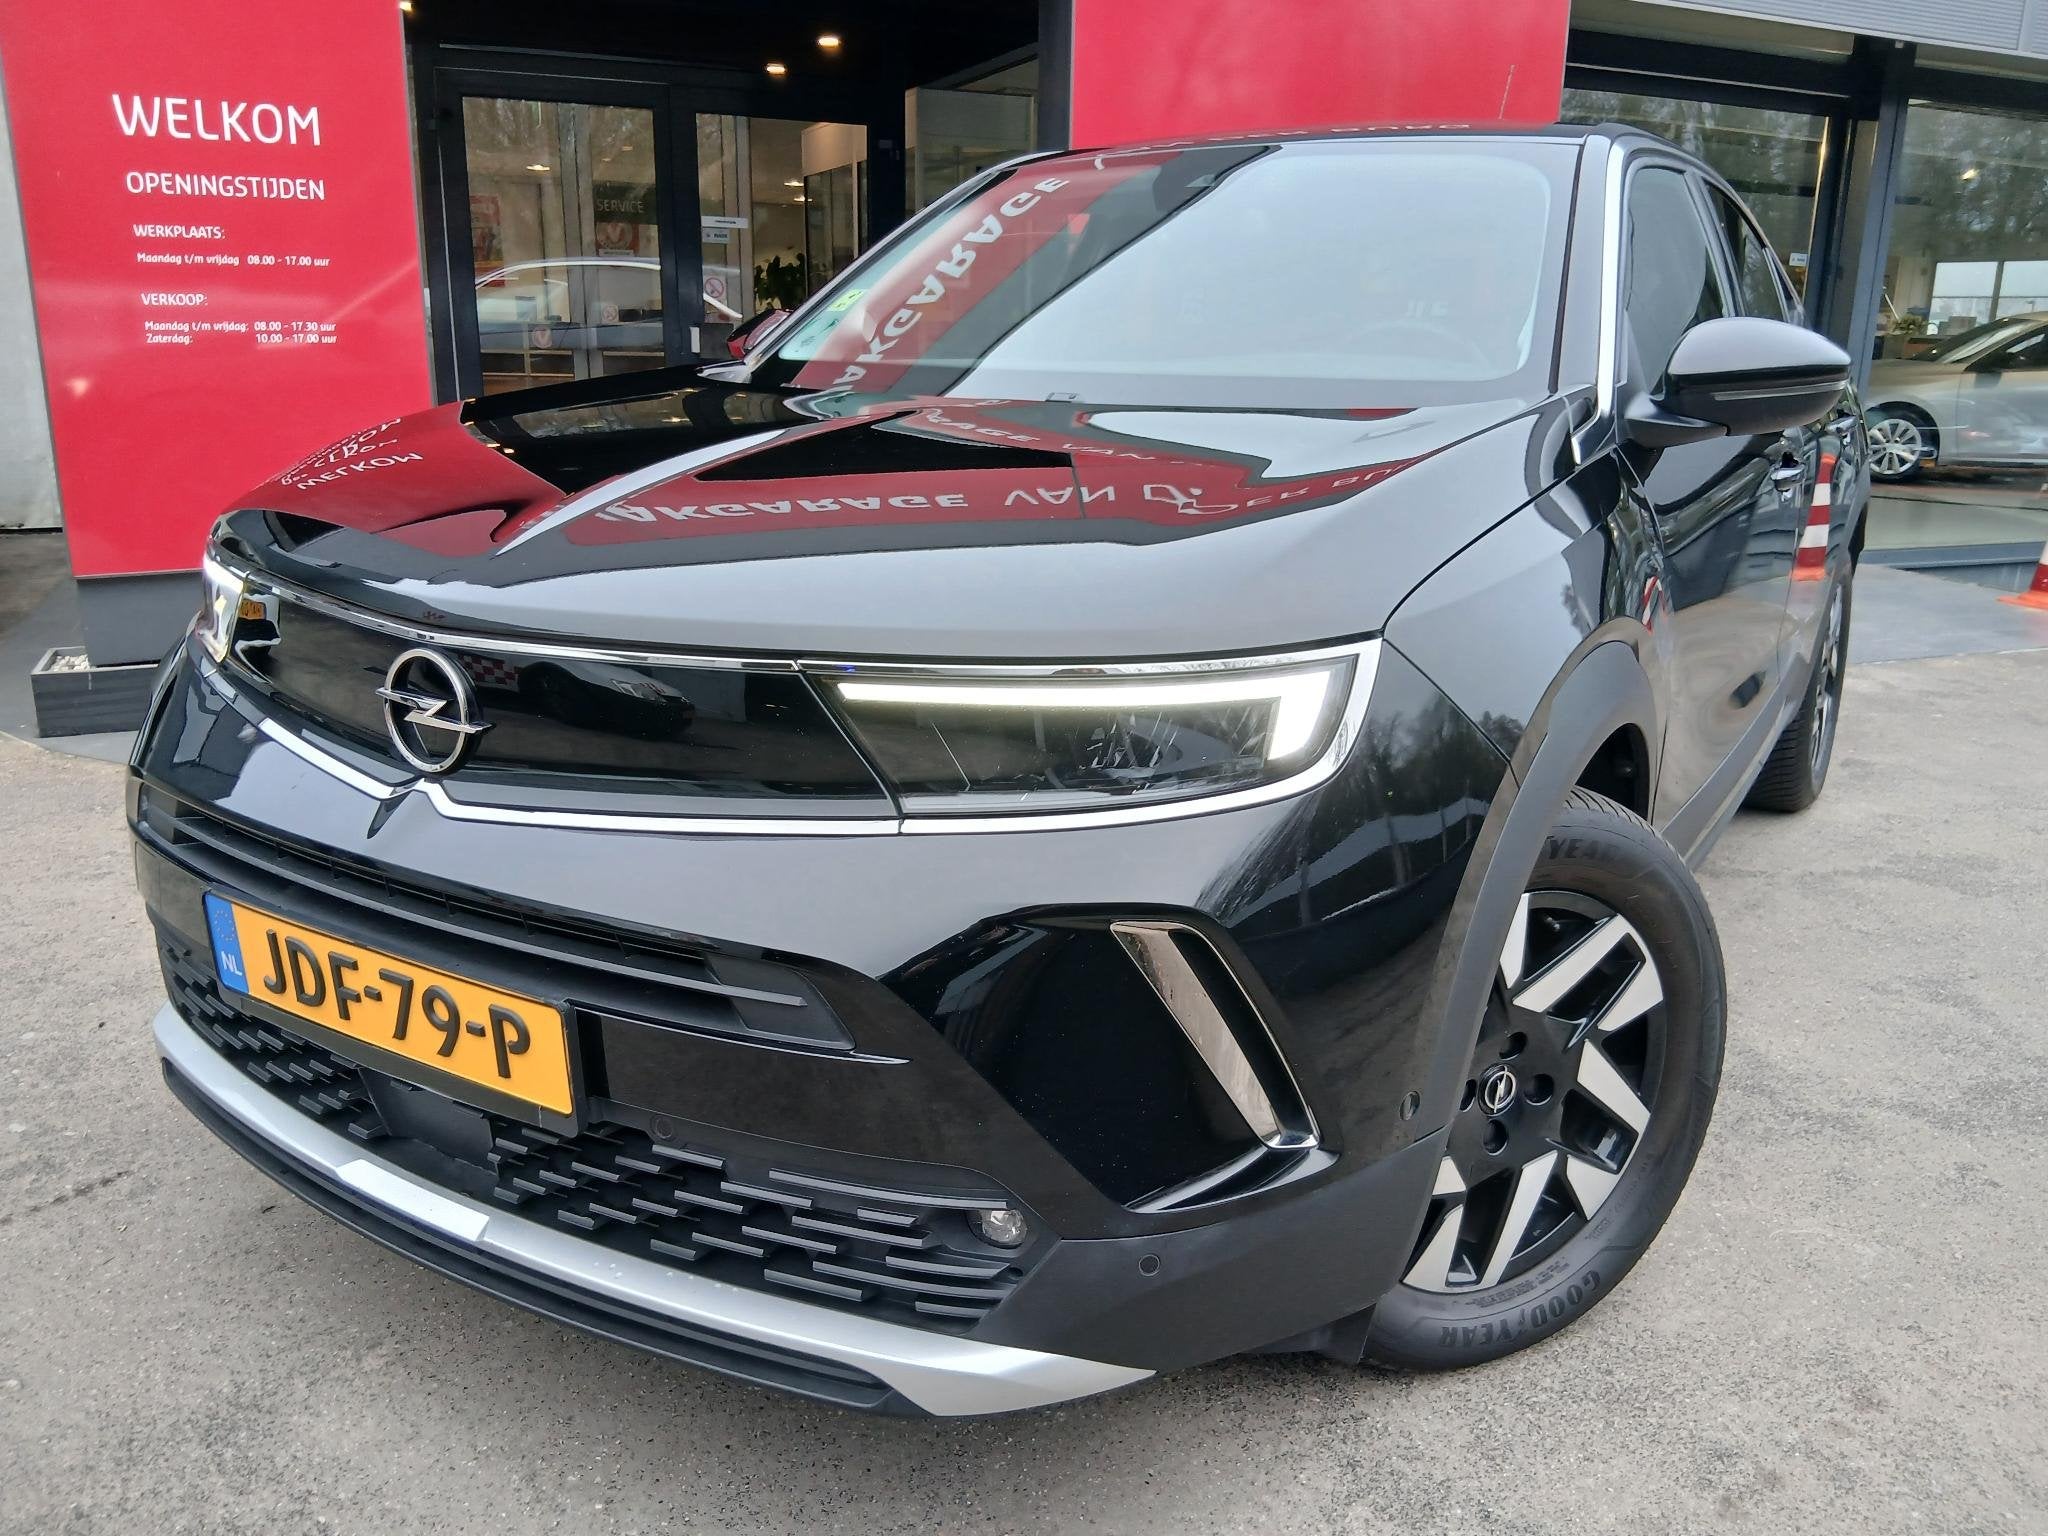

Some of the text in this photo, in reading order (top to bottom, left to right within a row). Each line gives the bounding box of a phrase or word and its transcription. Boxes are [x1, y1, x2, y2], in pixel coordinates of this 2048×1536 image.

[112, 94, 321, 146] WELKOM
[126, 171, 325, 201] OPENINGSTIJDEN
[597, 199, 645, 214] SERVICE
[133, 224, 226, 239] WERKPLAATS:
[137, 252, 182, 265] Maandag
[184, 253, 204, 264] t/m
[206, 254, 240, 266] vrijdag
[247, 255, 275, 266] 08.00
[284, 255, 312, 266] 17.00
[314, 257, 331, 267] uur
[141, 293, 208, 306] VERKOOP:
[144, 320, 190, 332] Maandag
[192, 321, 211, 331] t/m
[254, 321, 282, 331] 08.00
[320, 323, 336, 331] uur
[146, 333, 193, 344] Zaterdag:
[256, 333, 283, 343] 10.00
[292, 333, 319, 343] 17.00
[321, 335, 337, 344] uur
[220, 950, 243, 977] NL
[263, 929, 531, 1079] JDF-79-P
